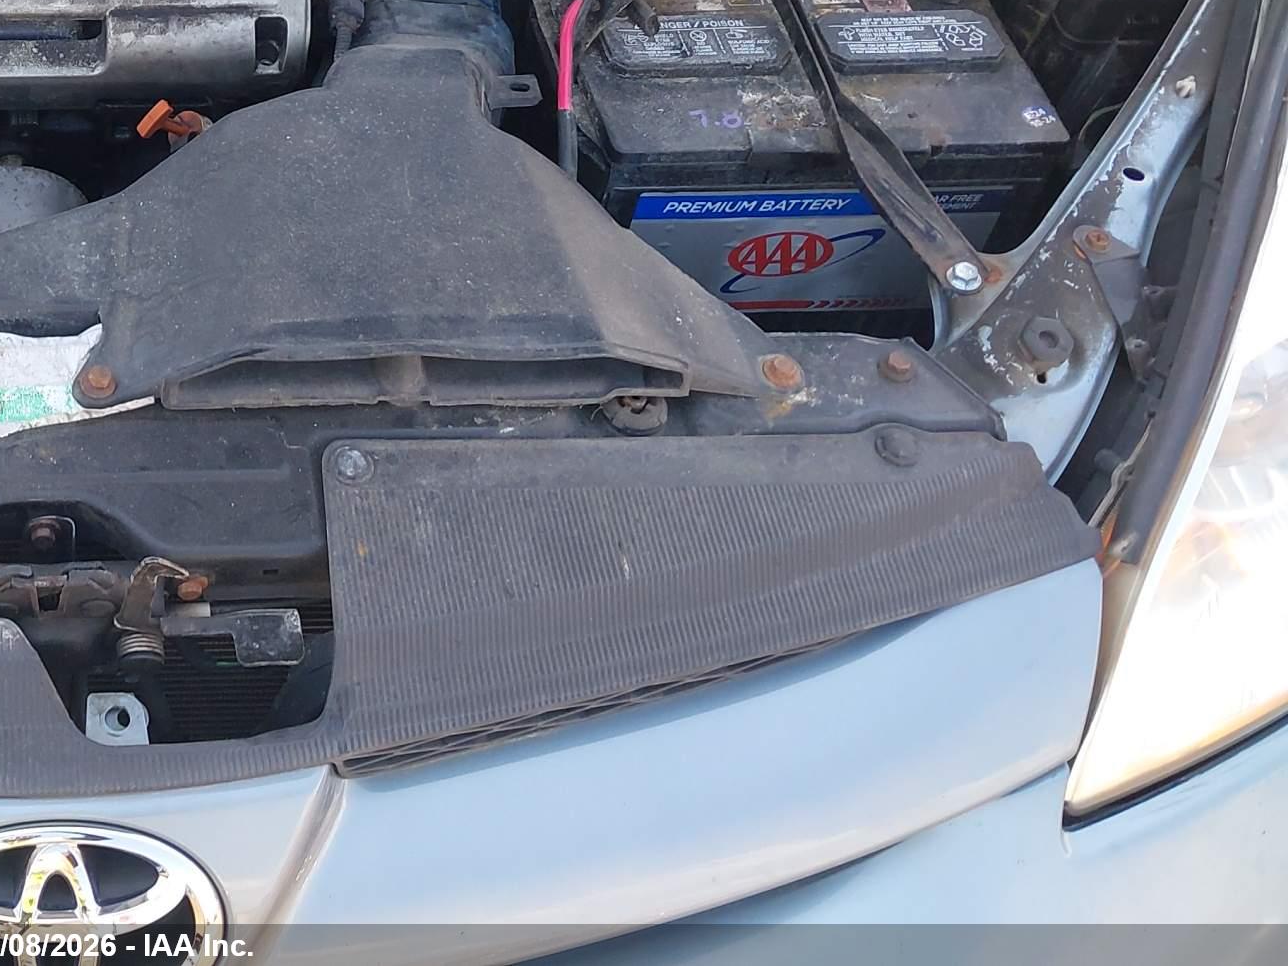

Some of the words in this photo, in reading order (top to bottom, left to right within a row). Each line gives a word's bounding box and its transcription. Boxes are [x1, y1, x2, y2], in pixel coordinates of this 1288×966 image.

[951, 193, 984, 202] FREE
[663, 200, 758, 214] PREMIUM
[759, 198, 852, 213] BATTERY
[729, 231, 832, 277] AAA
